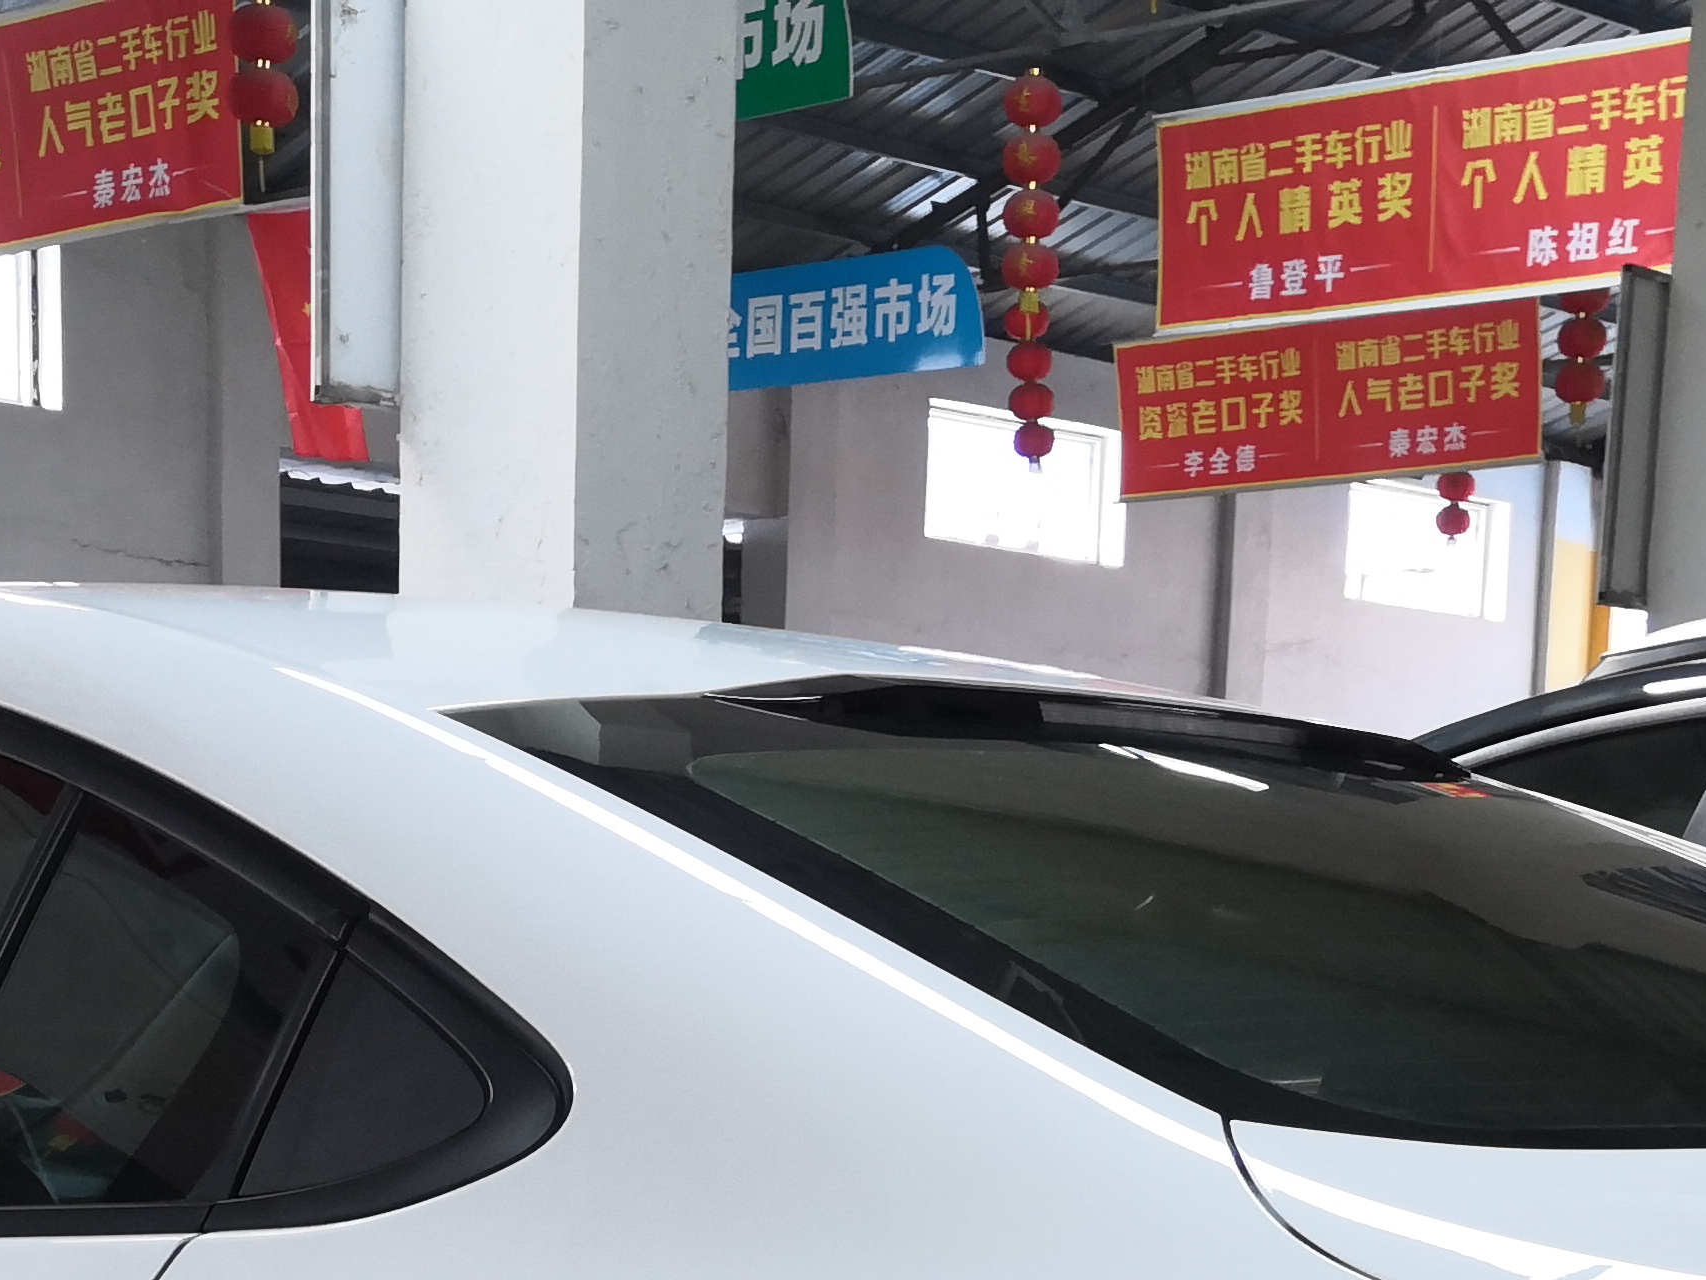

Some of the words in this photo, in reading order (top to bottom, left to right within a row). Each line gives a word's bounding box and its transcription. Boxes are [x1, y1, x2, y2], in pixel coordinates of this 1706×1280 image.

[25, 9, 218, 93] 湖南省二手车行业
[38, 70, 220, 158] 人气老口子奖
[1185, 119, 1413, 190] 湖南省二手车行业
[1461, 134, 1664, 210] 个人精英
[1186, 172, 1413, 246] 个人精英奖
[1526, 216, 1641, 267] 陈祖红
[1249, 254, 1345, 301] 鲁登平
[1134, 347, 1302, 396] 湖南省二手车行业
[1334, 319, 1521, 371] 湖南省二手车行业
[1338, 362, 1521, 418] 人气老口子奖
